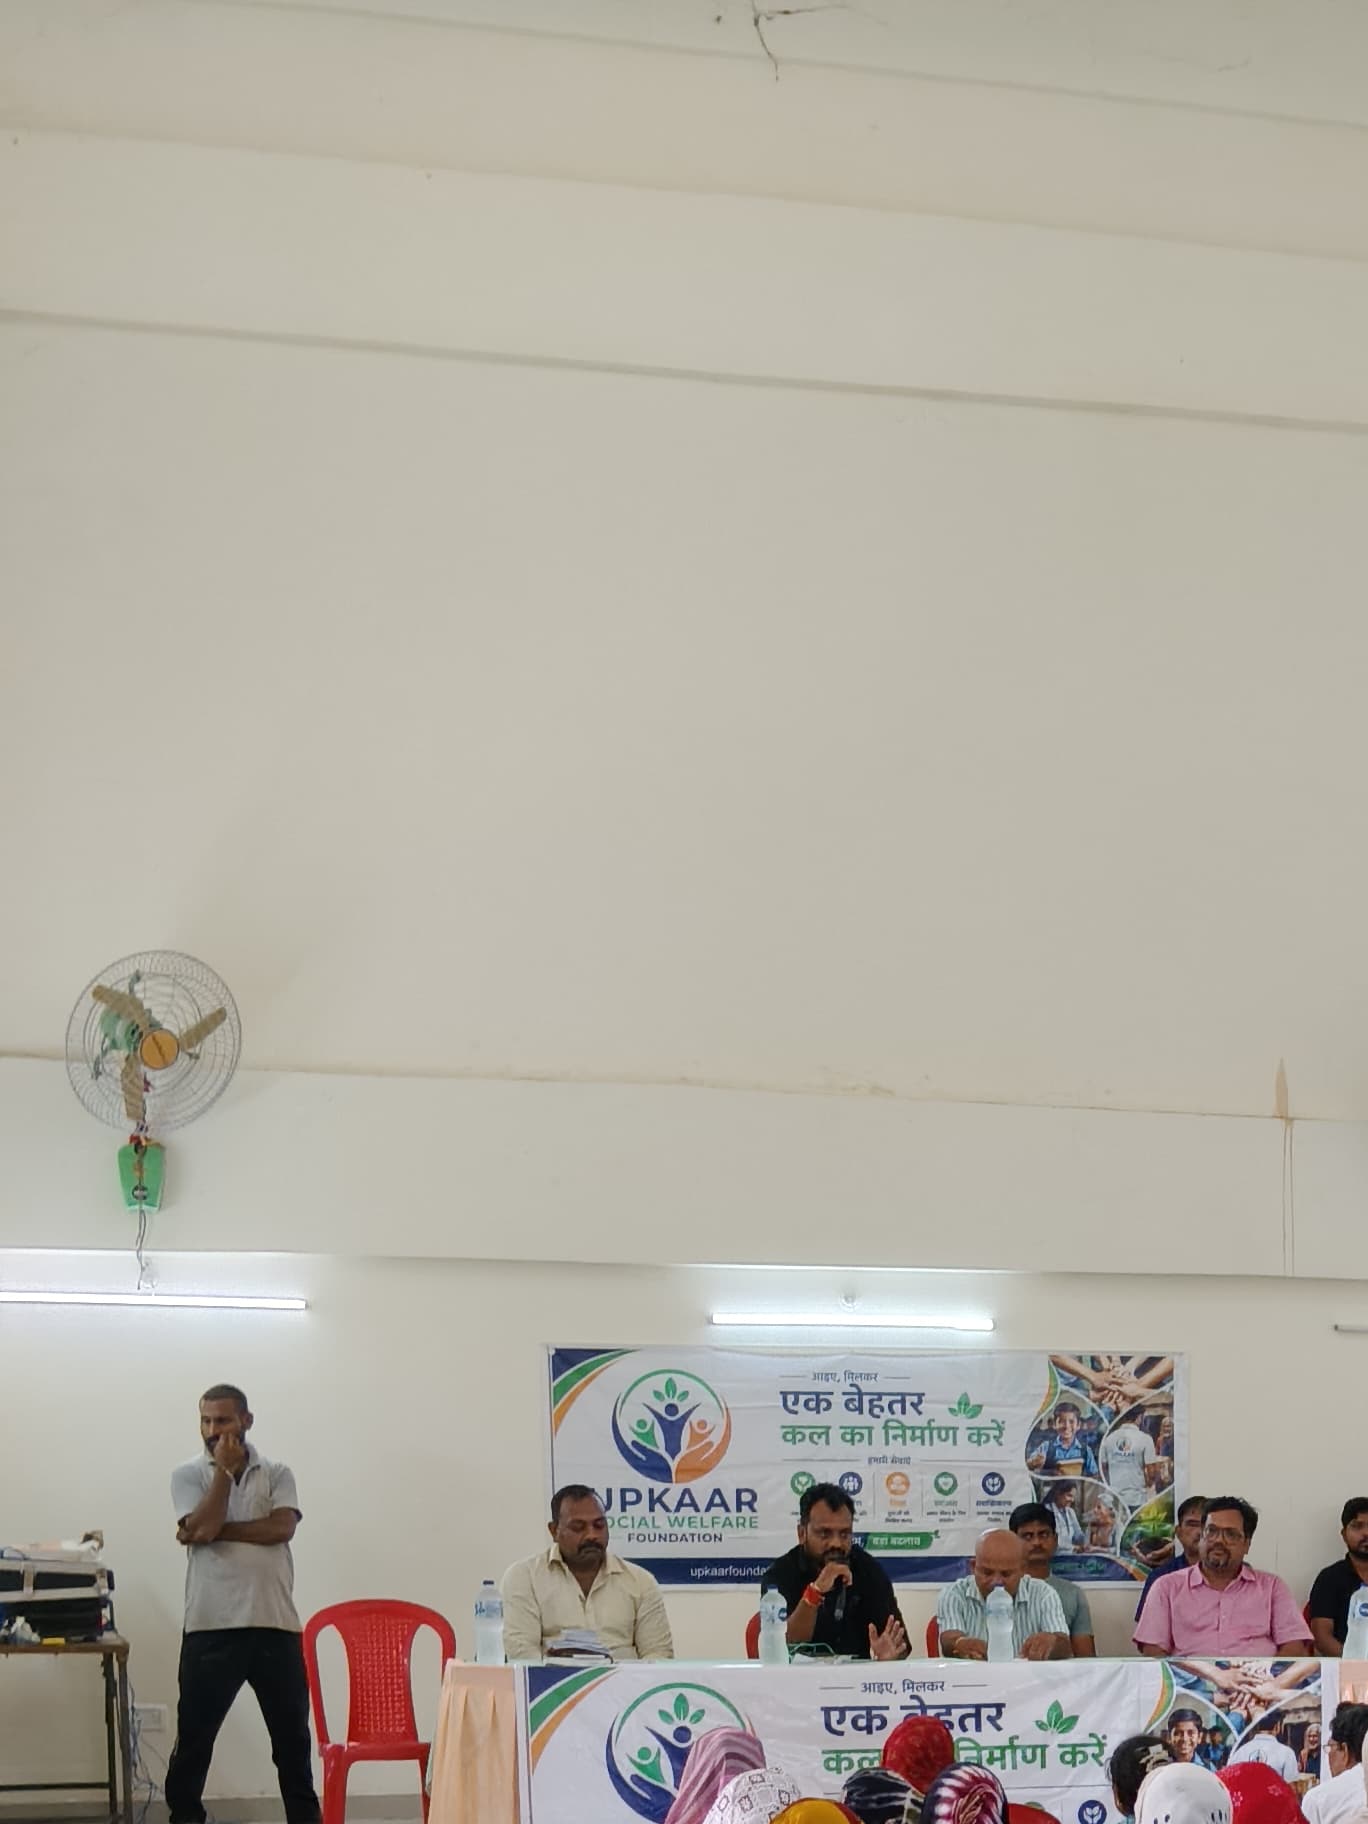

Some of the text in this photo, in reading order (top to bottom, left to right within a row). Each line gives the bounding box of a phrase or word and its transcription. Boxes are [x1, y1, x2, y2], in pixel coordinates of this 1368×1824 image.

[844, 1369, 880, 1383] मिलकर
[779, 1383, 926, 1419] एक बेहतर
[780, 1418, 1007, 1447] कल का निर्माण करें
[606, 1515, 760, 1529] OCIAL WELFARE
[627, 1532, 724, 1543] FOUNDATION
[690, 1565, 769, 1580] upkaarfounda
[860, 1678, 945, 1695] आइए, मिलकर
[820, 1705, 890, 1736] एक
[1057, 1732, 1108, 1768] करें
